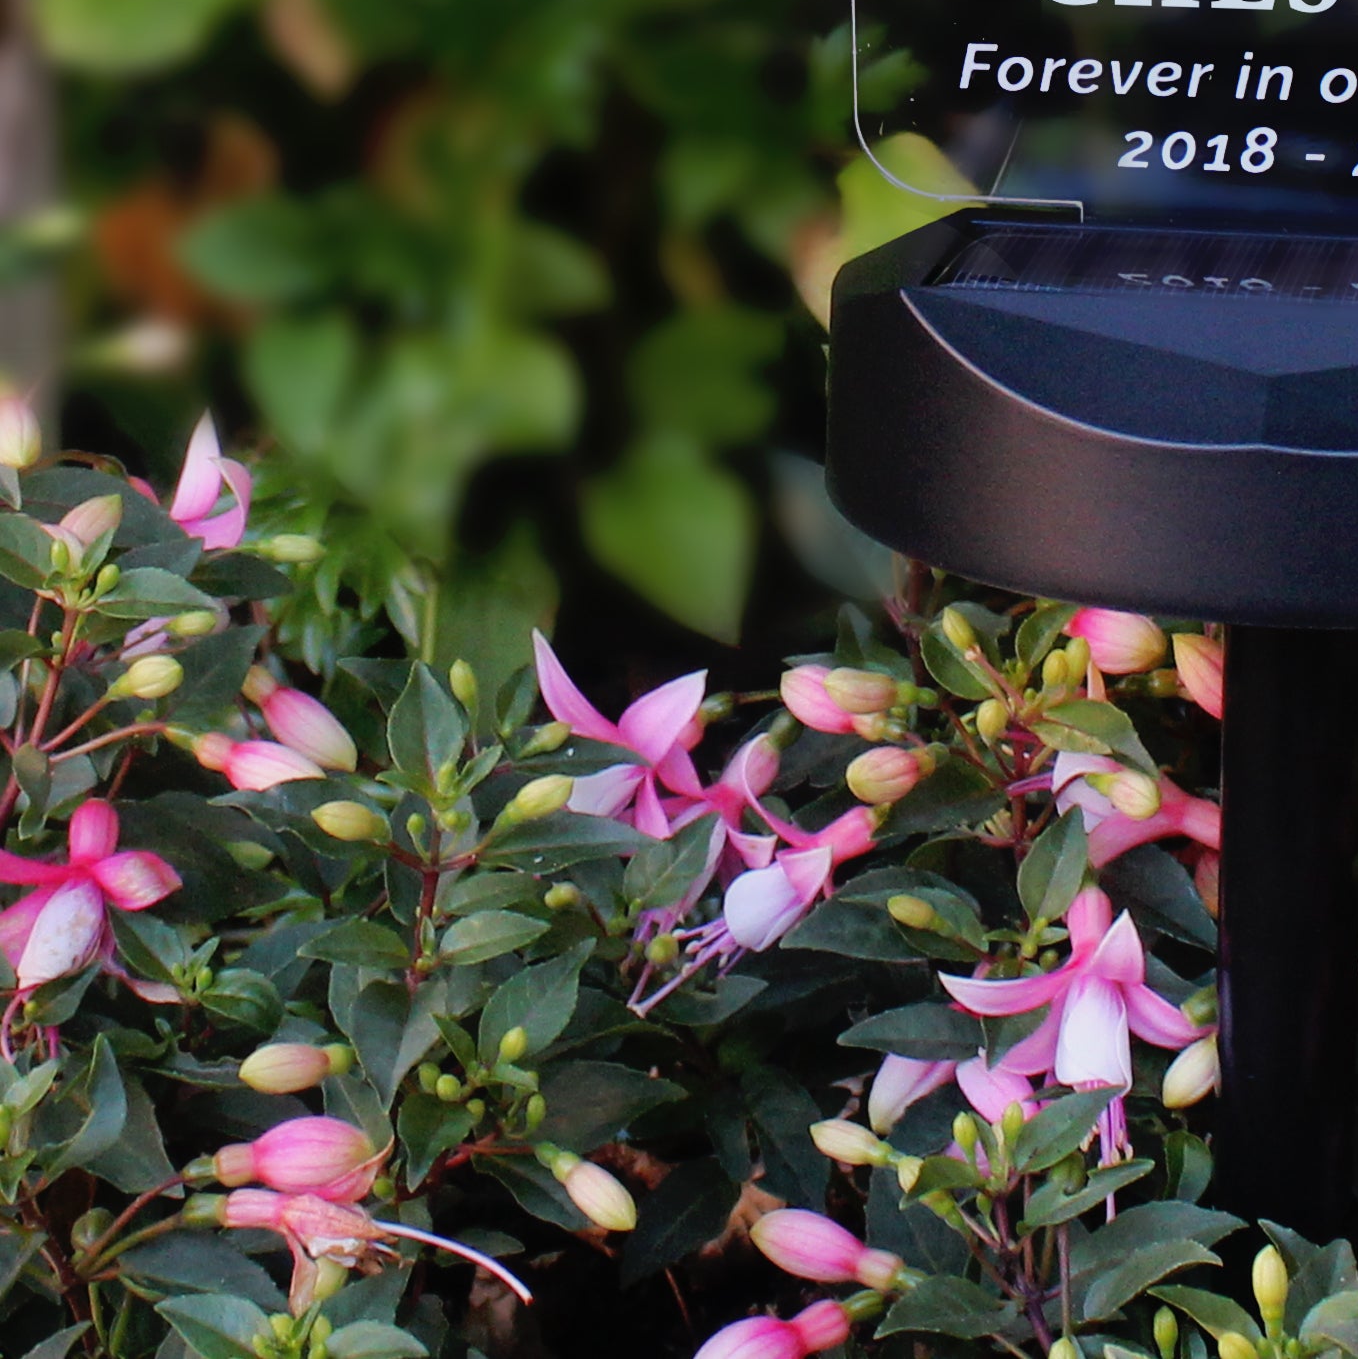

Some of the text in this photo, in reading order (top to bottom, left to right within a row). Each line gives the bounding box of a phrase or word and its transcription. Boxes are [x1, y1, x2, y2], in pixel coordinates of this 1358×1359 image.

[959, 42, 1215, 98] Forever
[1235, 51, 1294, 102] in
[1117, 126, 1279, 174] 2018
[1304, 152, 1327, 162] -
